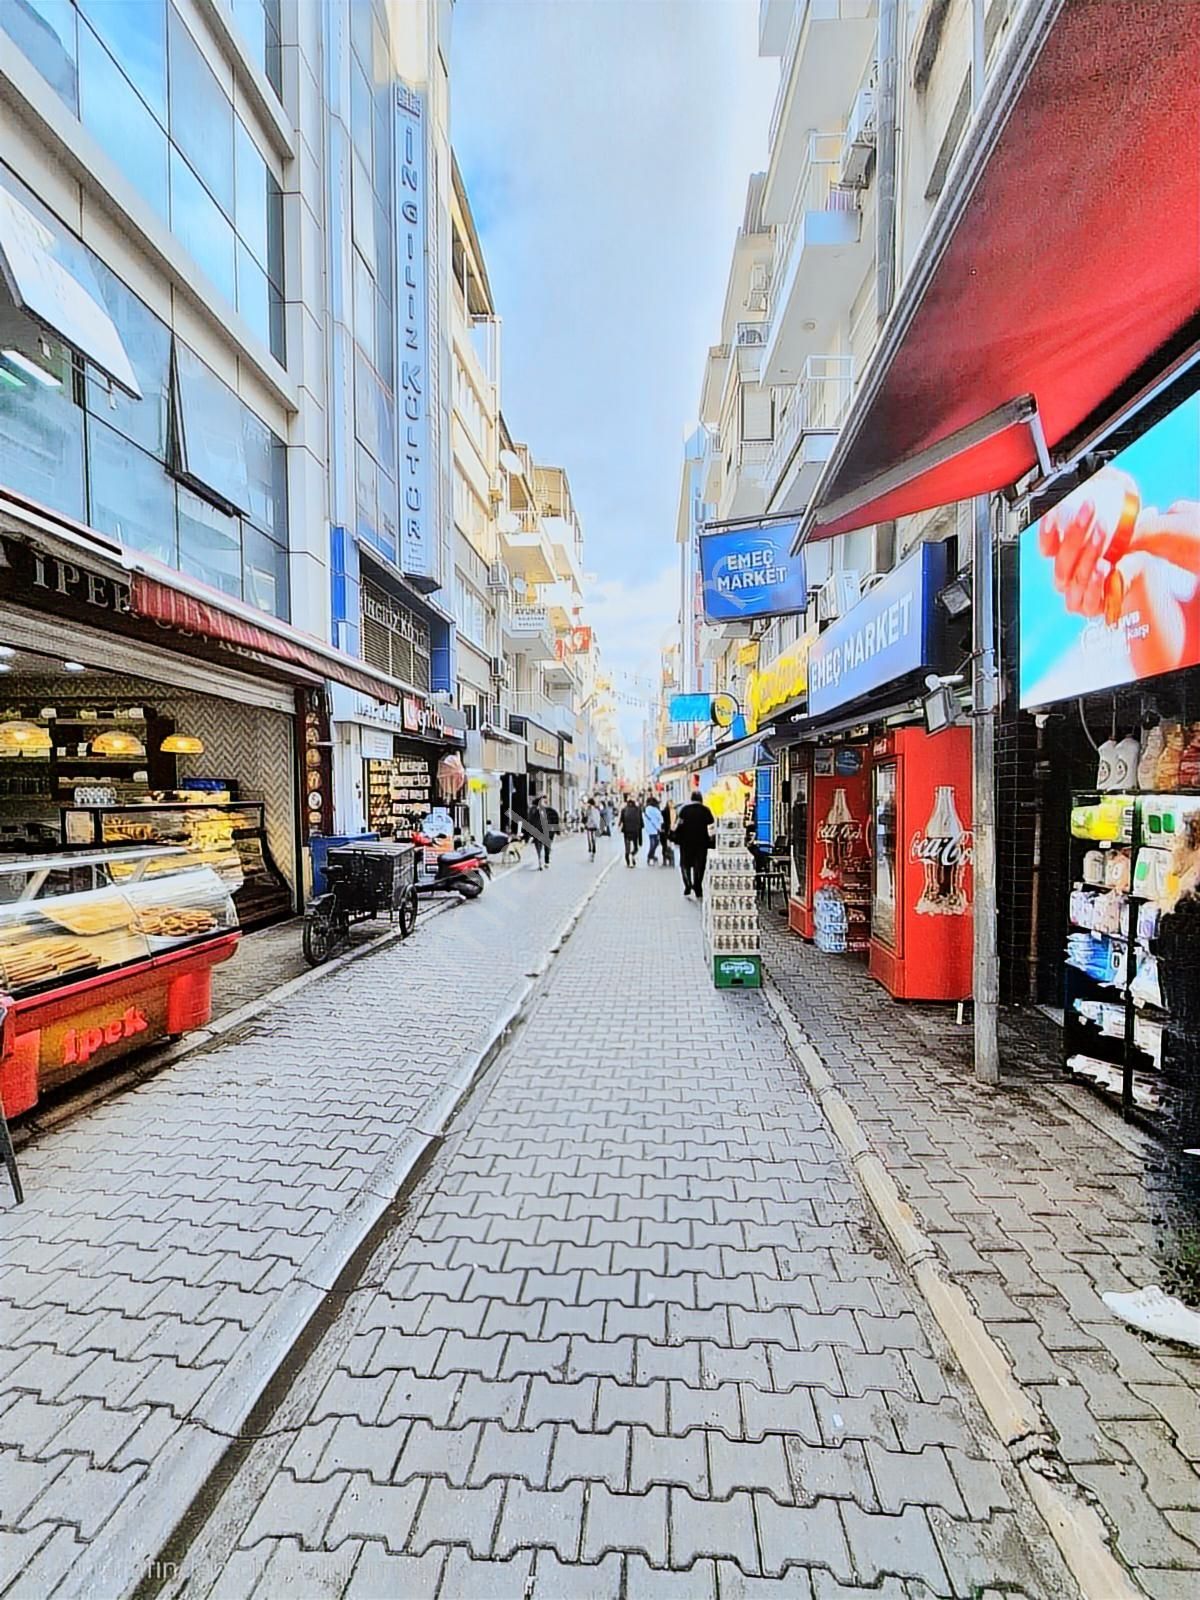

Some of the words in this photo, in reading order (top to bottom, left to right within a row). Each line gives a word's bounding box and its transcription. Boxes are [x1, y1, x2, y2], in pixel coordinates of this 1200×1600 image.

[401, 359, 422, 540] KÜLTÜR
[717, 566, 787, 592] MARKET
[727, 549, 774, 570] EMEÇ
[810, 647, 841, 693] EMEÇ
[843, 591, 913, 673] MARKET
